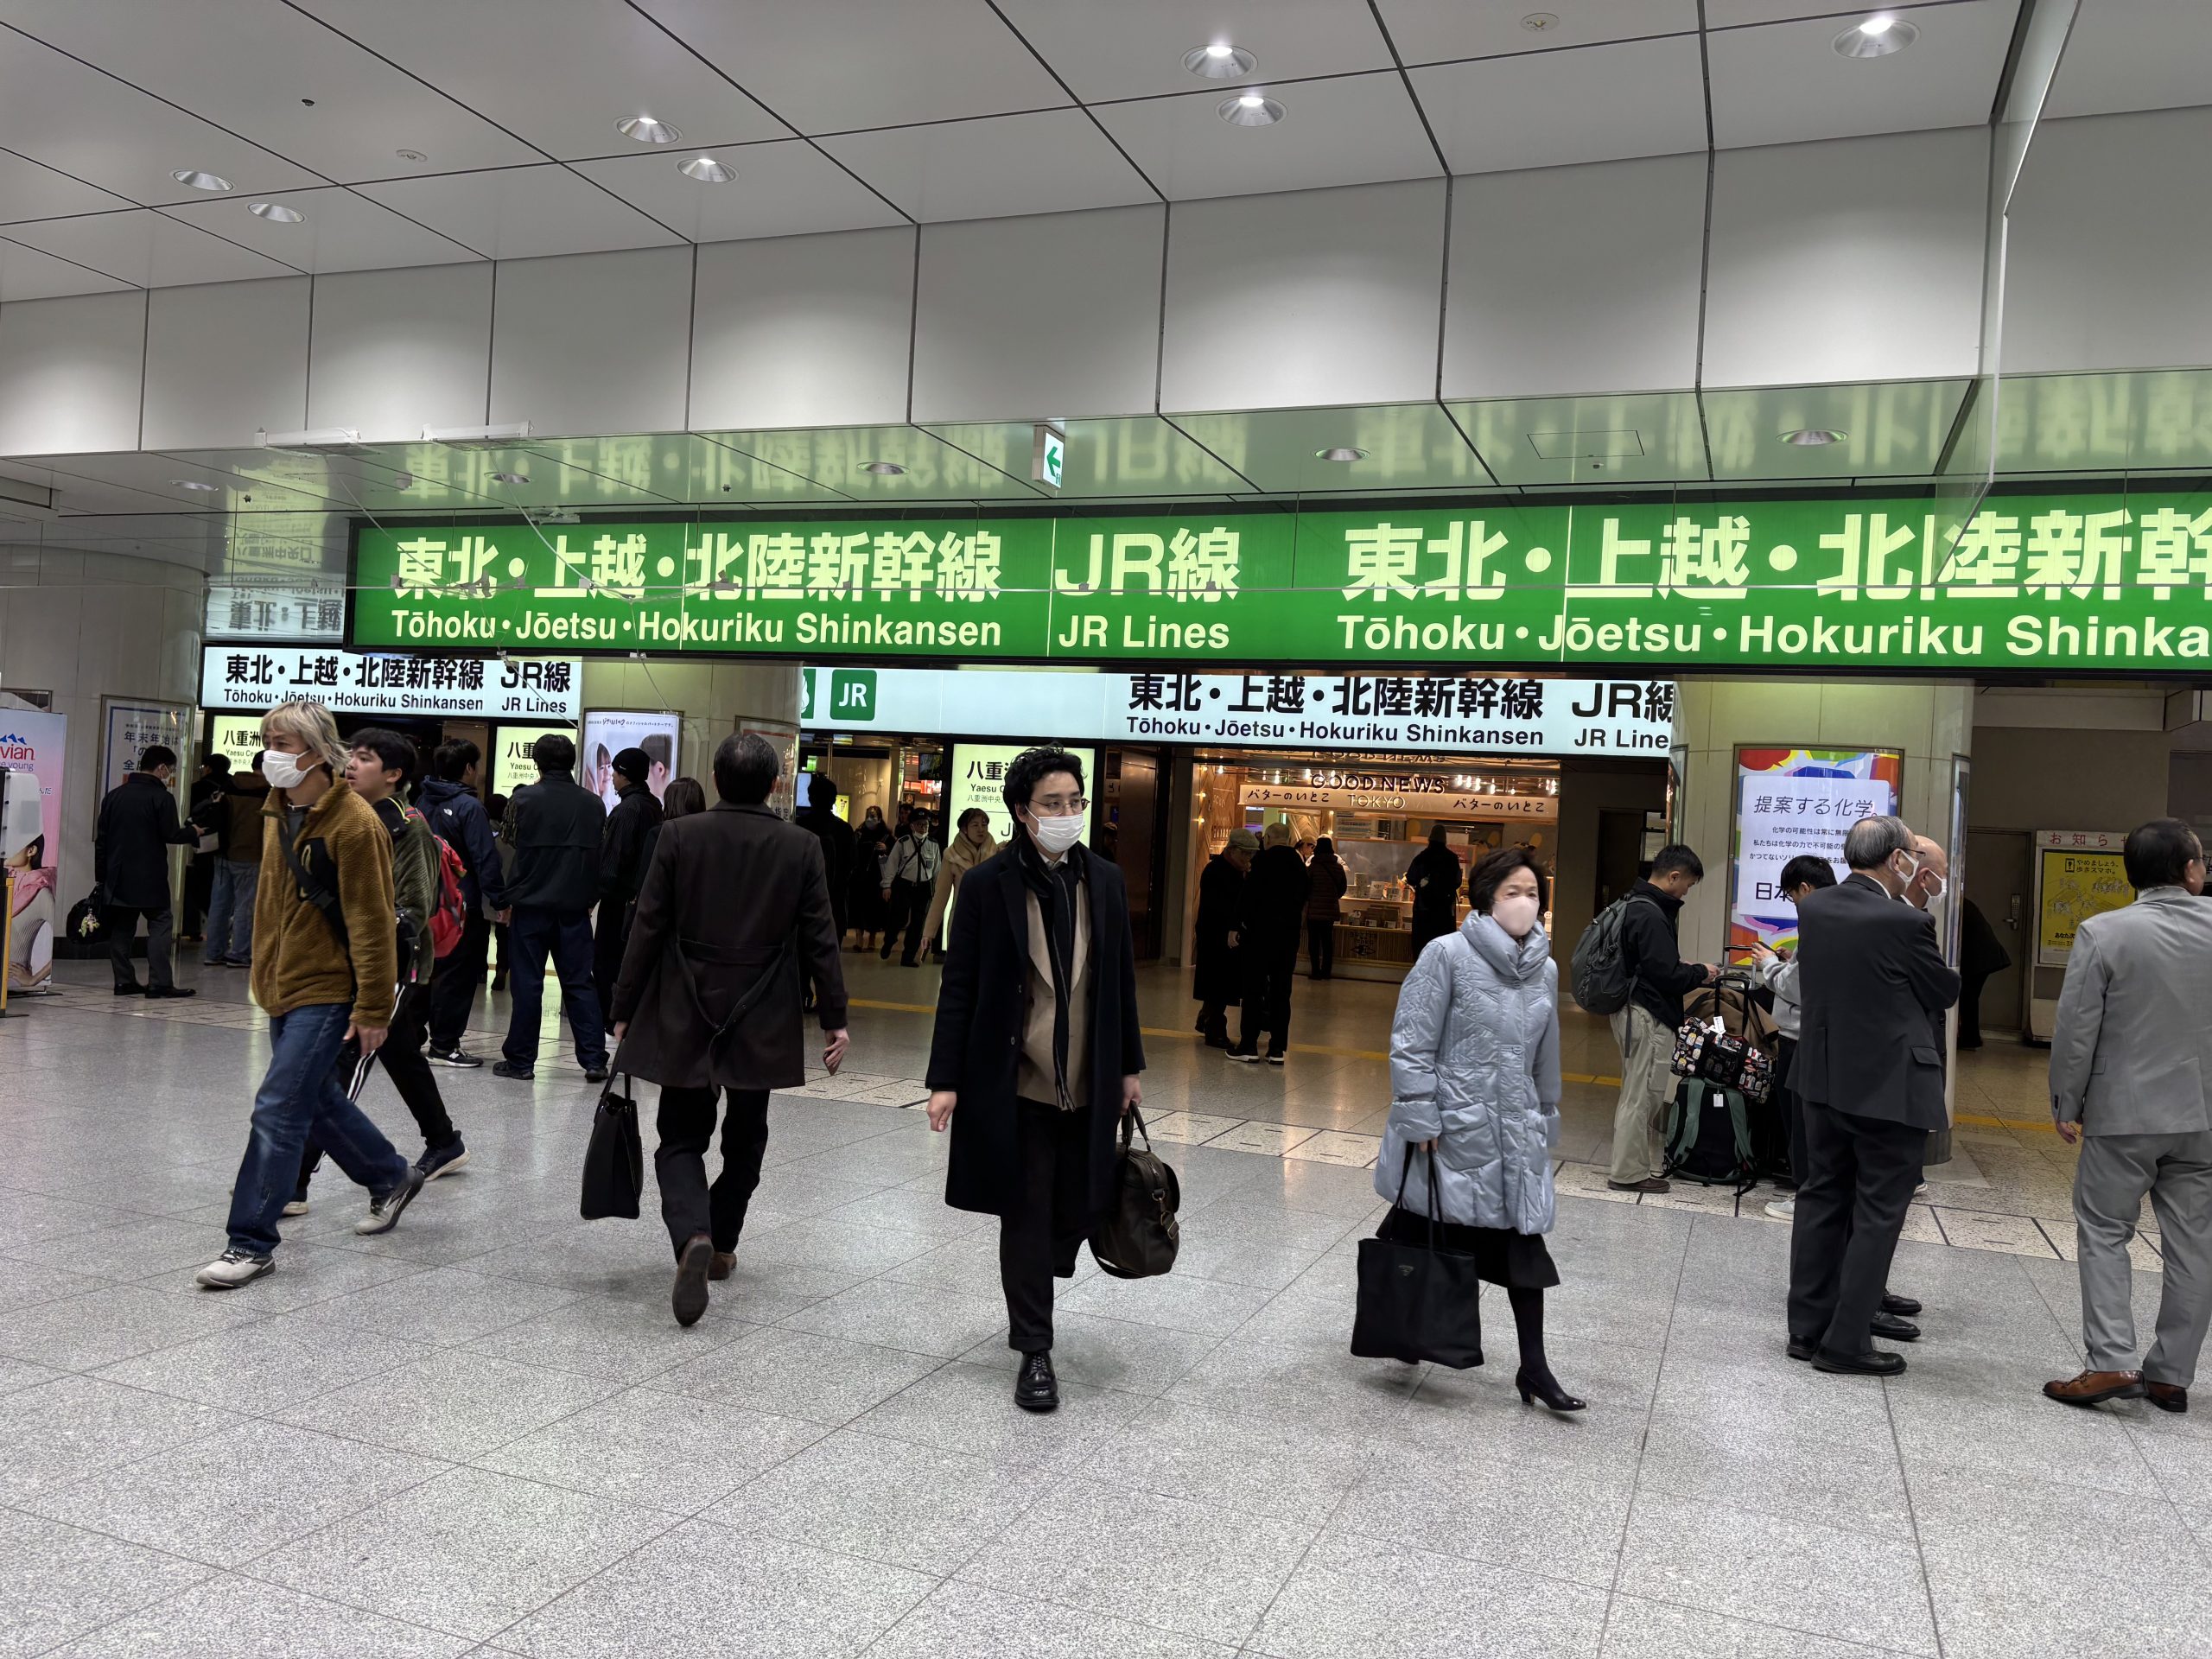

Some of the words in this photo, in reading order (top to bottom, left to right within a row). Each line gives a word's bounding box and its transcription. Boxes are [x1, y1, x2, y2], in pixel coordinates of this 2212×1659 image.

[1055, 527, 1240, 602] JR線
[797, 612, 1001, 646] Shinkansen
[1058, 614, 1109, 648] JR
[1123, 614, 1230, 649] Lines
[2005, 614, 2212, 658] Shinka
[401, 694, 483, 710] Shinkansen
[838, 682, 868, 708] JR
[501, 696, 521, 711] JR
[526, 697, 567, 714] Lines
[223, 730, 261, 747] 八重洲
[1407, 723, 1543, 746] Shinkansen
[1574, 728, 1605, 747] JR
[1616, 729, 1669, 749] Line
[0, 744, 35, 760] vian
[507, 741, 536, 759] 八重
[510, 762, 531, 771] Yaesu
[967, 760, 1008, 781] 八重
[970, 784, 997, 793] Yaesu
[1311, 773, 1376, 791] GOOD
[1382, 777, 1446, 794] NEWS
[967, 794, 1004, 804] 八重洲中央
[1247, 789, 1330, 803] バターのいとこ
[1347, 793, 1406, 810] TOKYO
[1452, 798, 1545, 812] バターのいとこ
[1772, 826, 1848, 837] 化学の可能性は常に無限
[1753, 839, 1844, 850] 私たちは化学の力で不可能の
[1756, 881, 1790, 902] 日本
